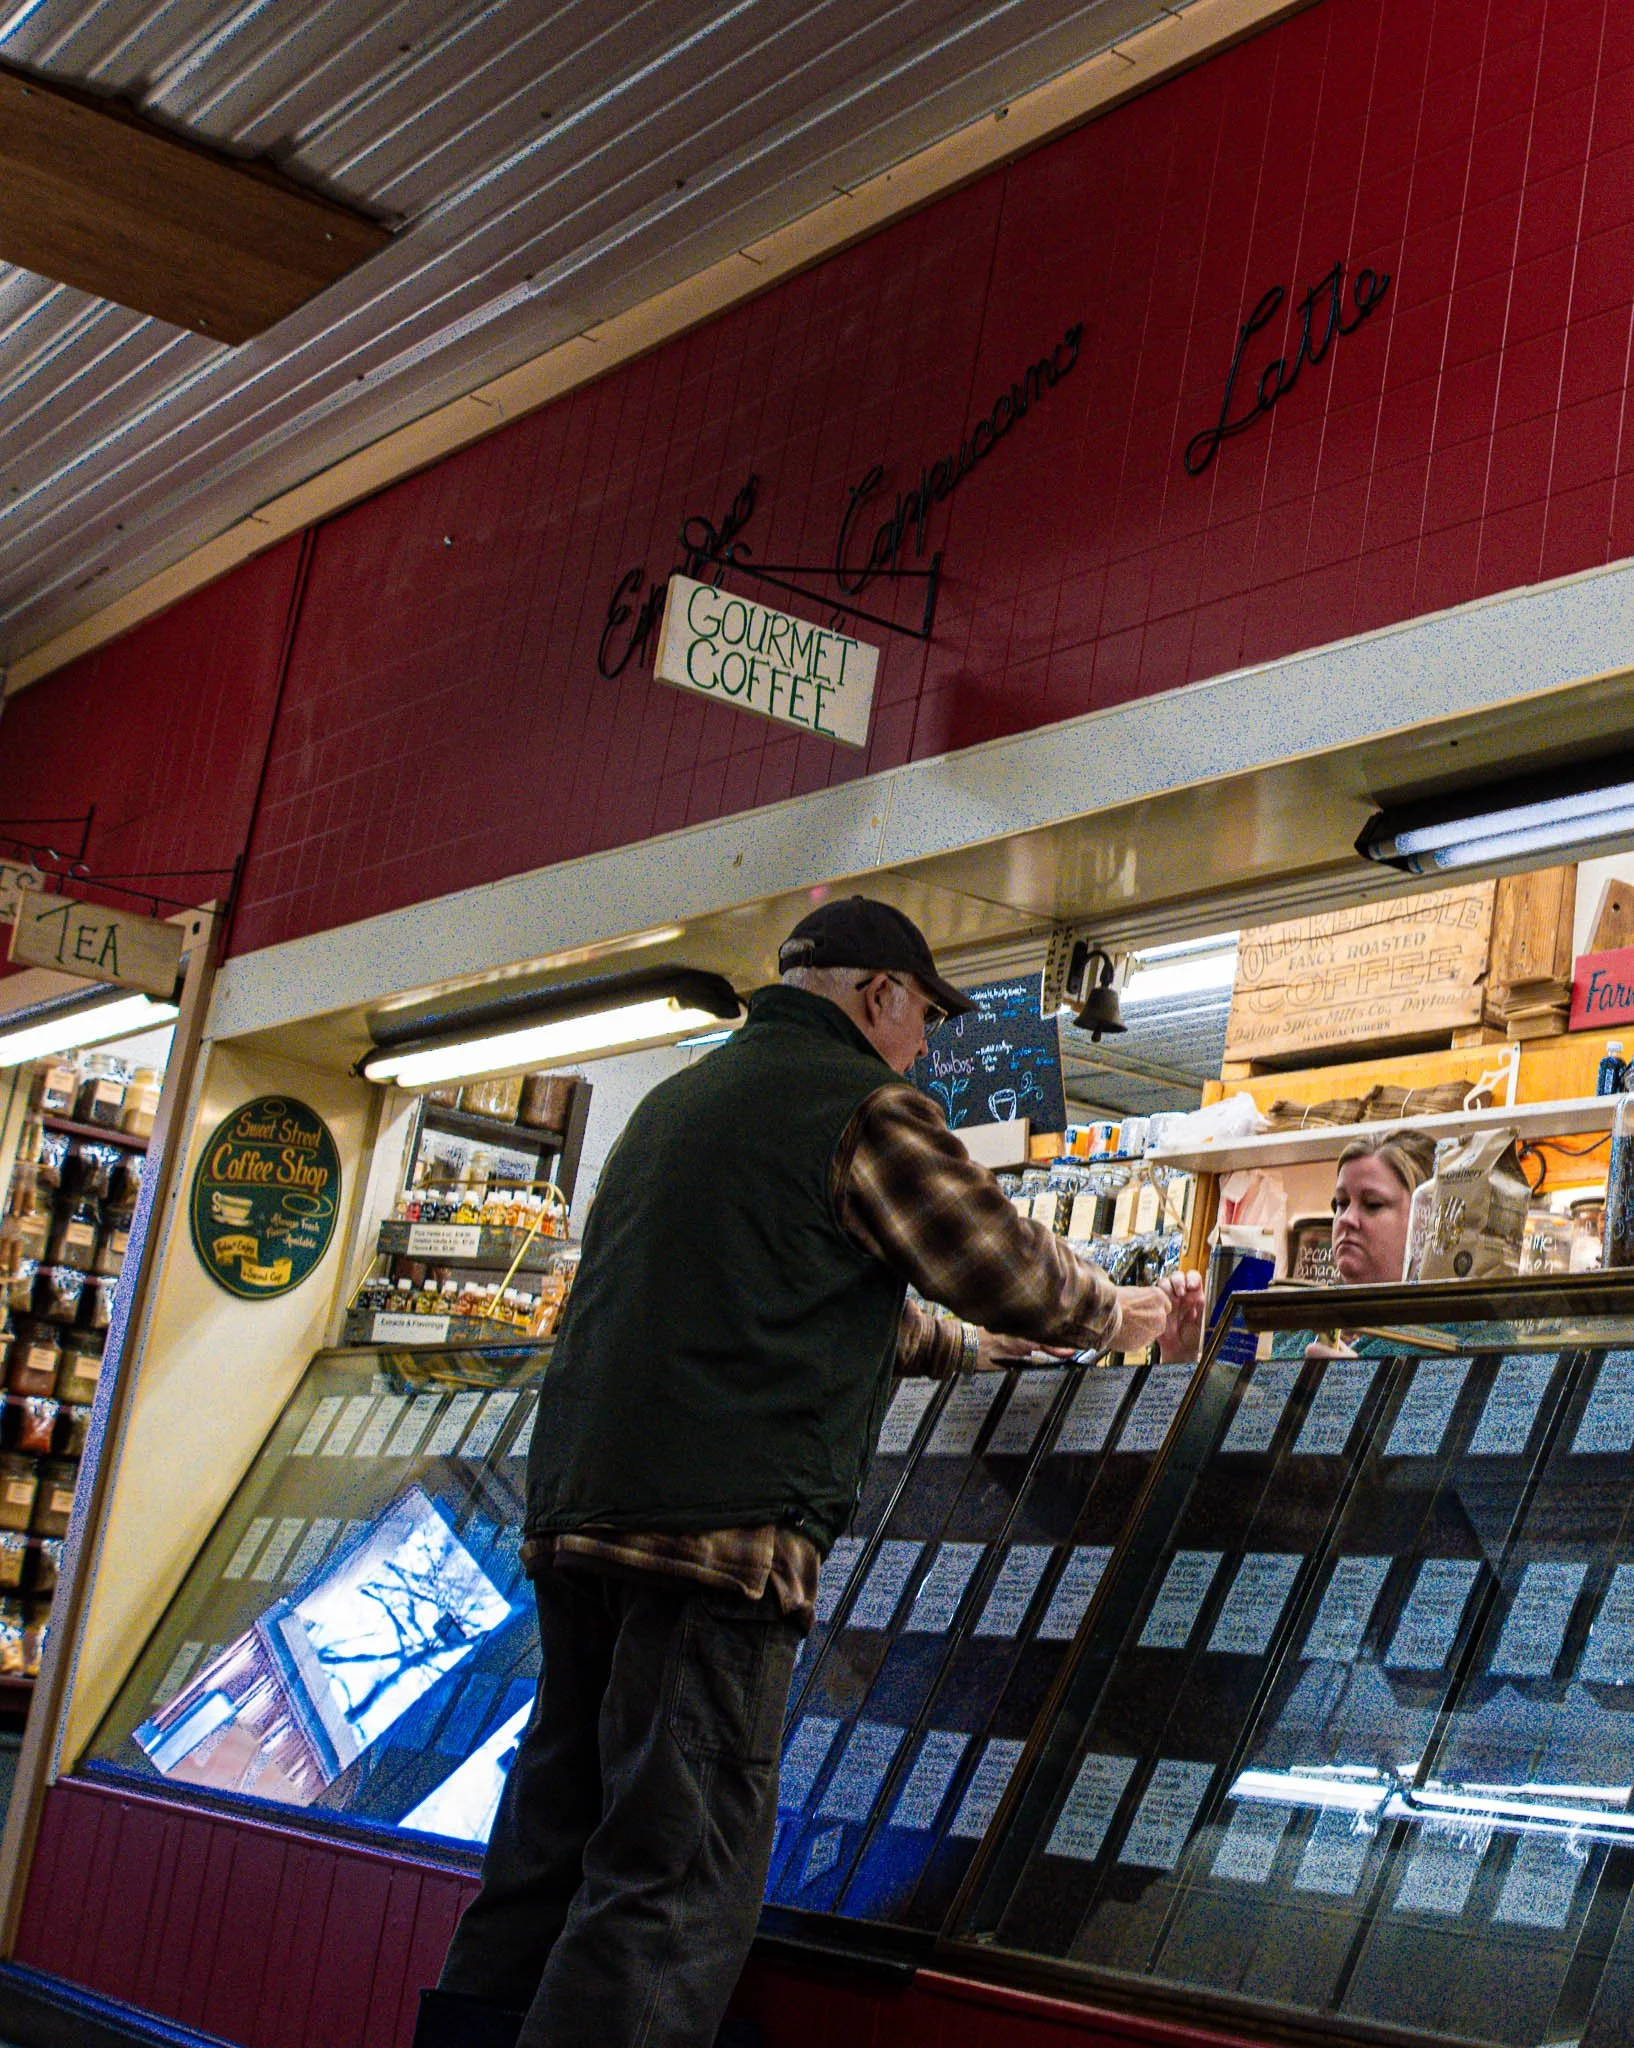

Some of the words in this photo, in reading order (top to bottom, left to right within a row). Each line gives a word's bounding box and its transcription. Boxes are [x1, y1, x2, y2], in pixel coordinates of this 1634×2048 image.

[1183, 260, 1391, 475] Latte
[835, 321, 1083, 594] Cappuccino
[687, 585, 859, 687] GOURMET
[686, 637, 836, 738] COFFEE
[35, 900, 120, 977] TEA
[1287, 950, 1337, 971] FANCY
[1346, 931, 1427, 960] ROASTED
[1247, 944, 1463, 1014] COFFEE
[1233, 1022, 1280, 1043] Dayton
[1282, 1012, 1325, 1036] Spice
[236, 1111, 277, 1140] Sweet
[278, 1118, 323, 1148] Street
[211, 1142, 274, 1183] Coffee
[275, 1147, 329, 1194] Shop
